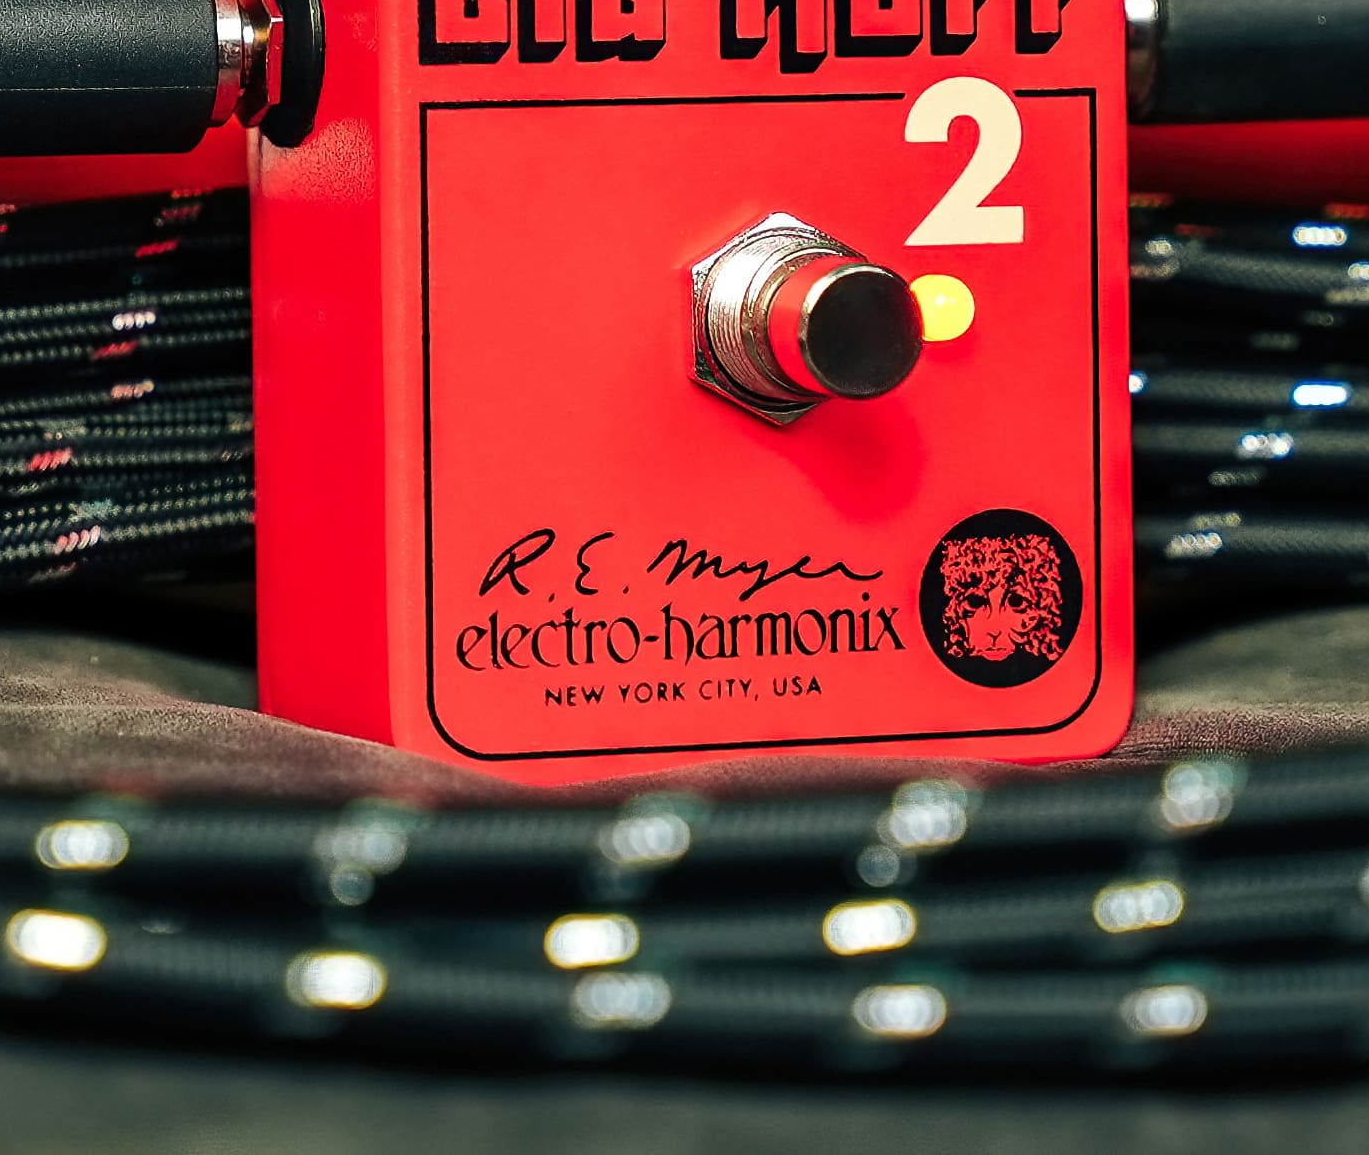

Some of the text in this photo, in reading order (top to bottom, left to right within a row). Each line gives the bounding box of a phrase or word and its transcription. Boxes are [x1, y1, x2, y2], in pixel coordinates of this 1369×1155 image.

[904, 75, 1025, 247] 2
[456, 592, 906, 671] electro-harmonix
[545, 675, 823, 707] NEW YORK CITY, USA
